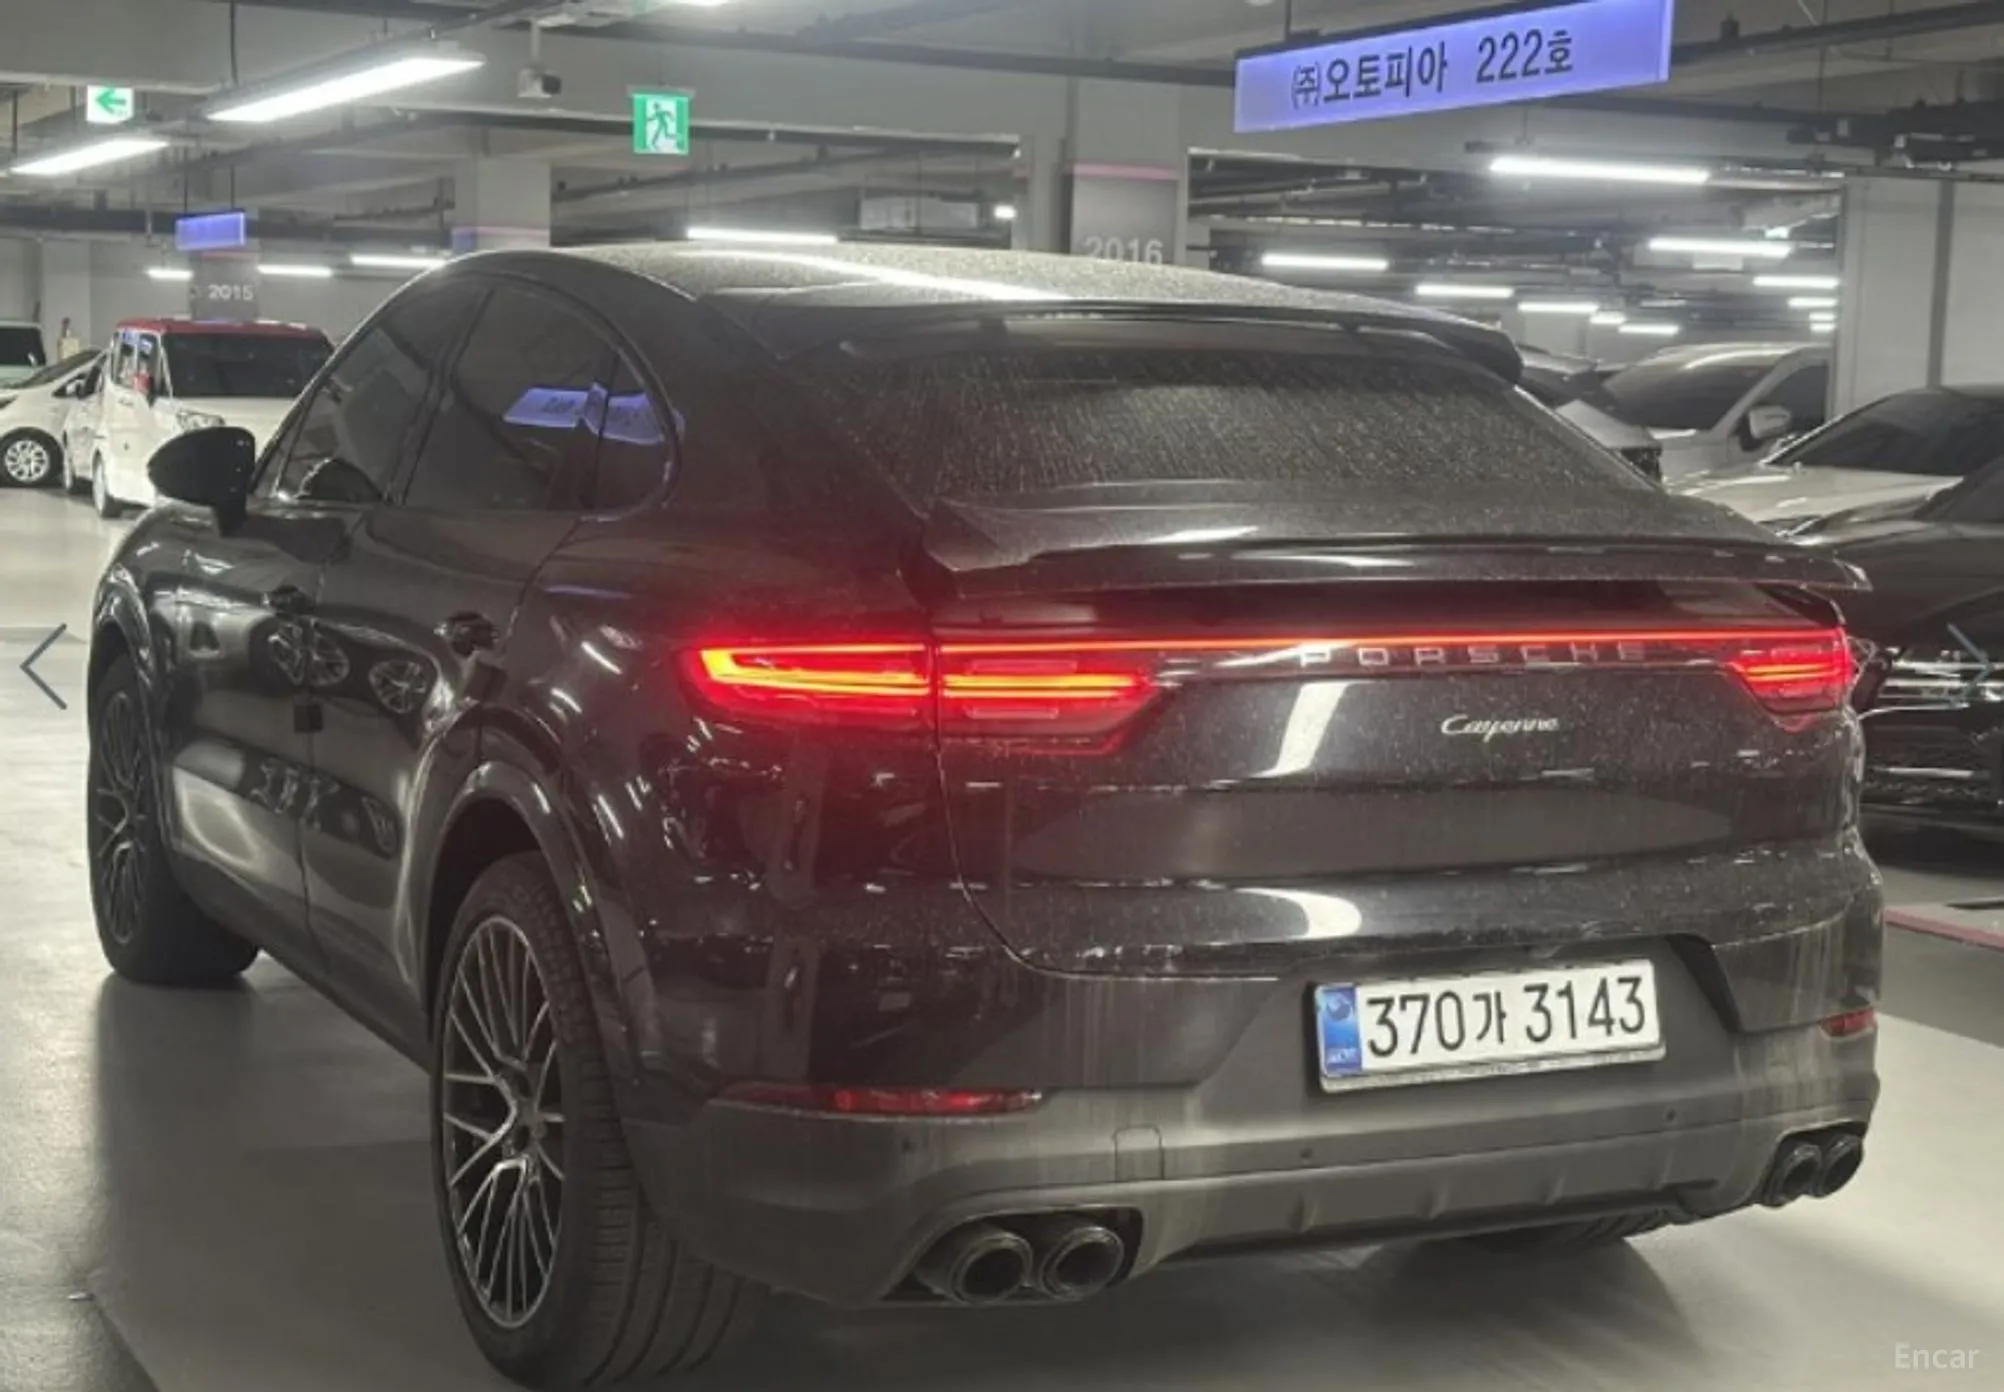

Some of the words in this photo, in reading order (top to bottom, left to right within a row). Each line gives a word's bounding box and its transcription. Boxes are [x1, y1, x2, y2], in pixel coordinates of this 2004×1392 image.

[1475, 29, 1574, 83] 222호
[1082, 236, 1164, 264] 2016
[207, 284, 255, 300] 2015
[1299, 641, 1645, 667] PORSCHE
[1441, 714, 1559, 742] Cayenne
[1366, 990, 1507, 1058] 370가
[1523, 976, 1647, 1044] 3143
